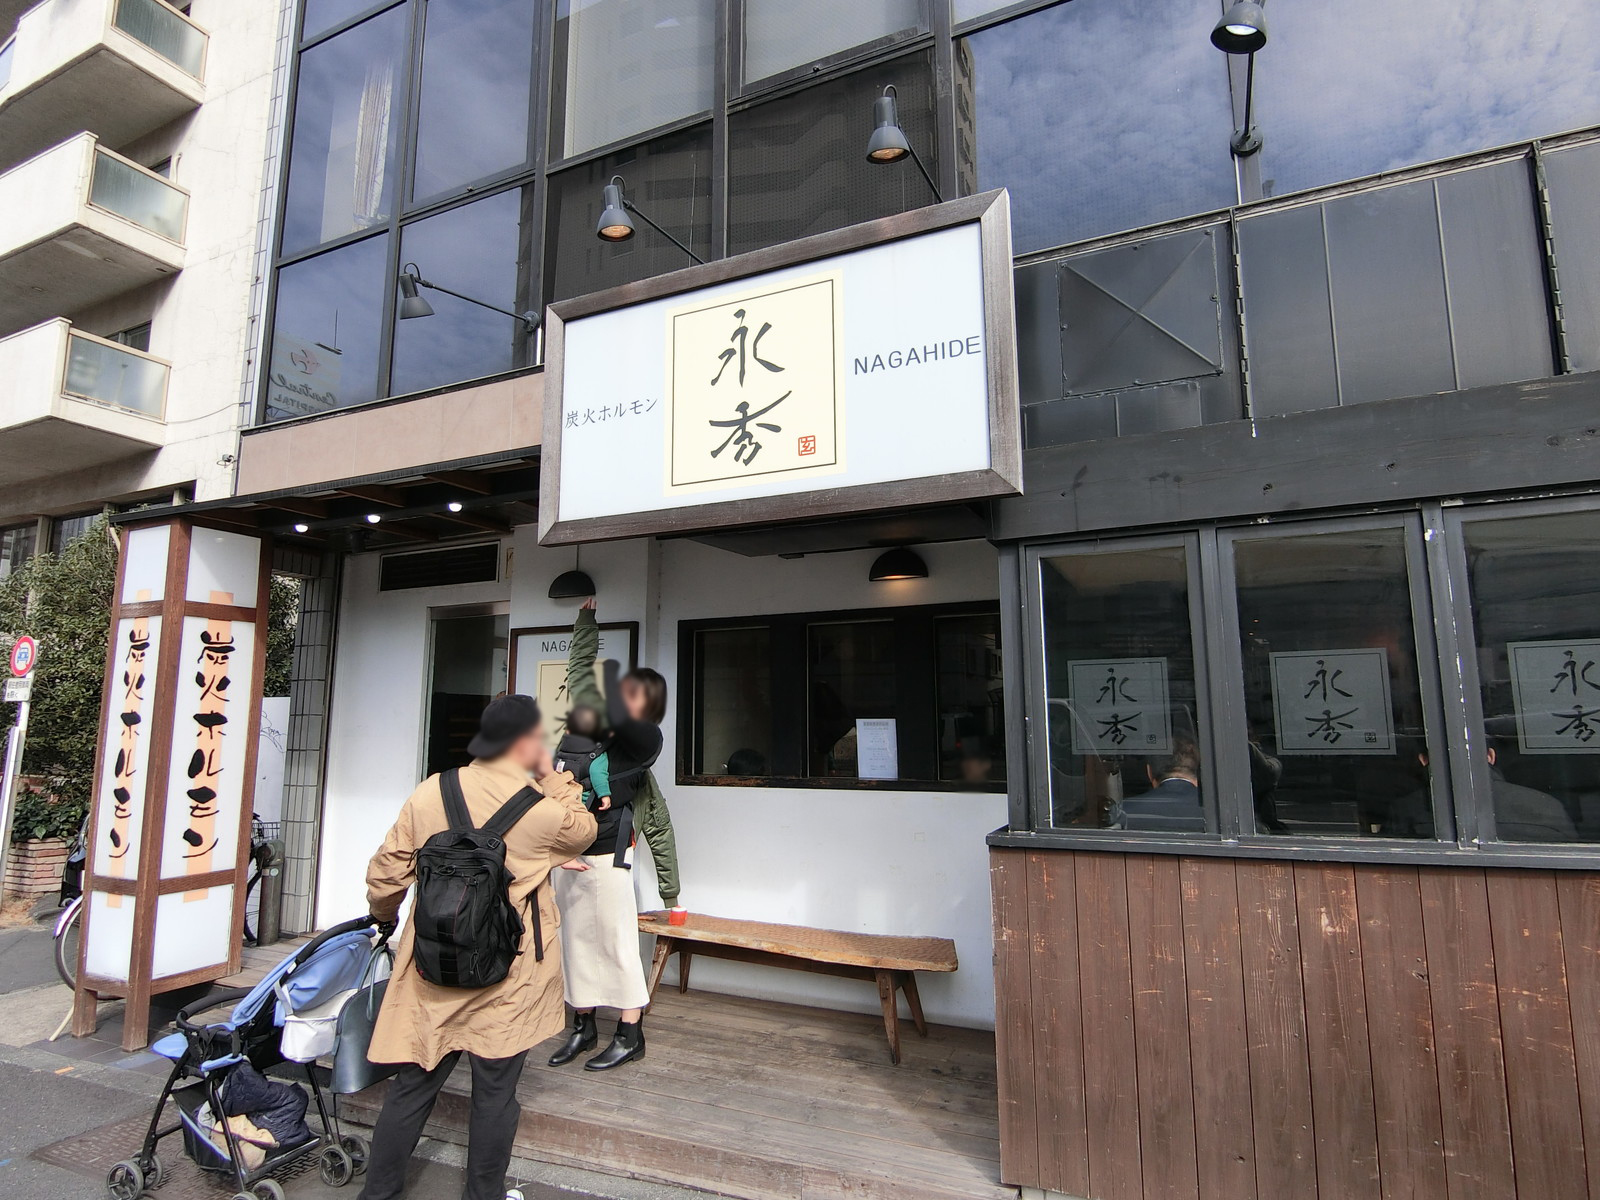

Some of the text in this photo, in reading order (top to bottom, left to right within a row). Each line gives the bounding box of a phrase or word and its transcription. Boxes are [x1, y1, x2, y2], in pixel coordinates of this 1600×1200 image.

[709, 308, 792, 466] 永秀
[853, 335, 982, 376] NAGAHIDE
[565, 397, 658, 429] 炭火ホルモン
[1096, 667, 1142, 744] 永秀
[1304, 660, 1359, 743] 永秀
[109, 629, 150, 858] 炭火ホルモン
[182, 630, 236, 858] 炭火ホルモン
